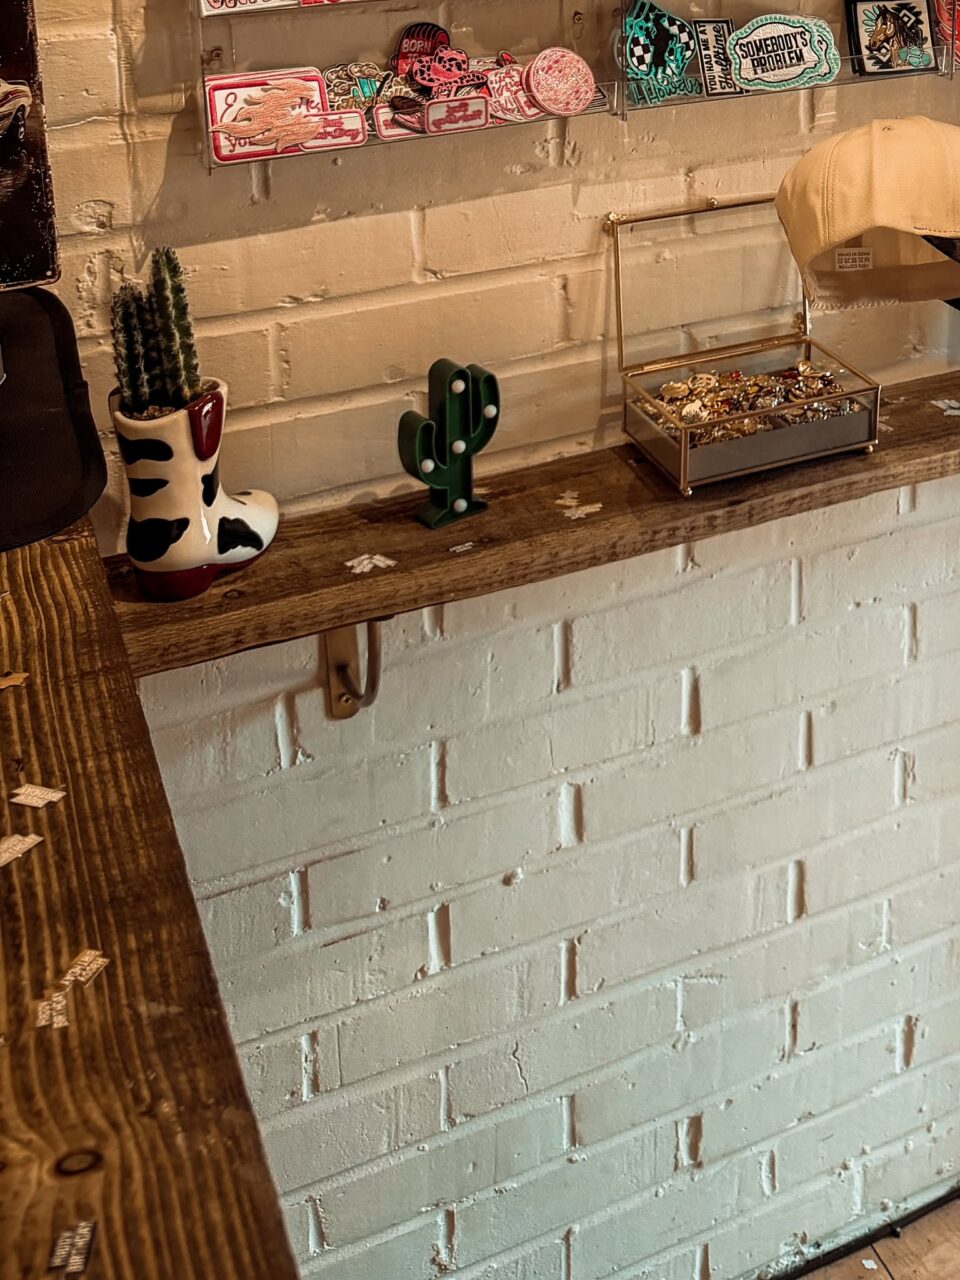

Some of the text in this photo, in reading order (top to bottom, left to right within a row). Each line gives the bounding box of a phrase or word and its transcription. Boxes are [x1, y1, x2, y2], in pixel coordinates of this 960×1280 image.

[402, 39, 432, 52] BORN
[698, 24, 718, 92] YOU HAD ME AT
[713, 23, 733, 89] Halftime
[738, 31, 808, 59] SOMEBODY'S
[751, 49, 805, 75] PROBLEM
